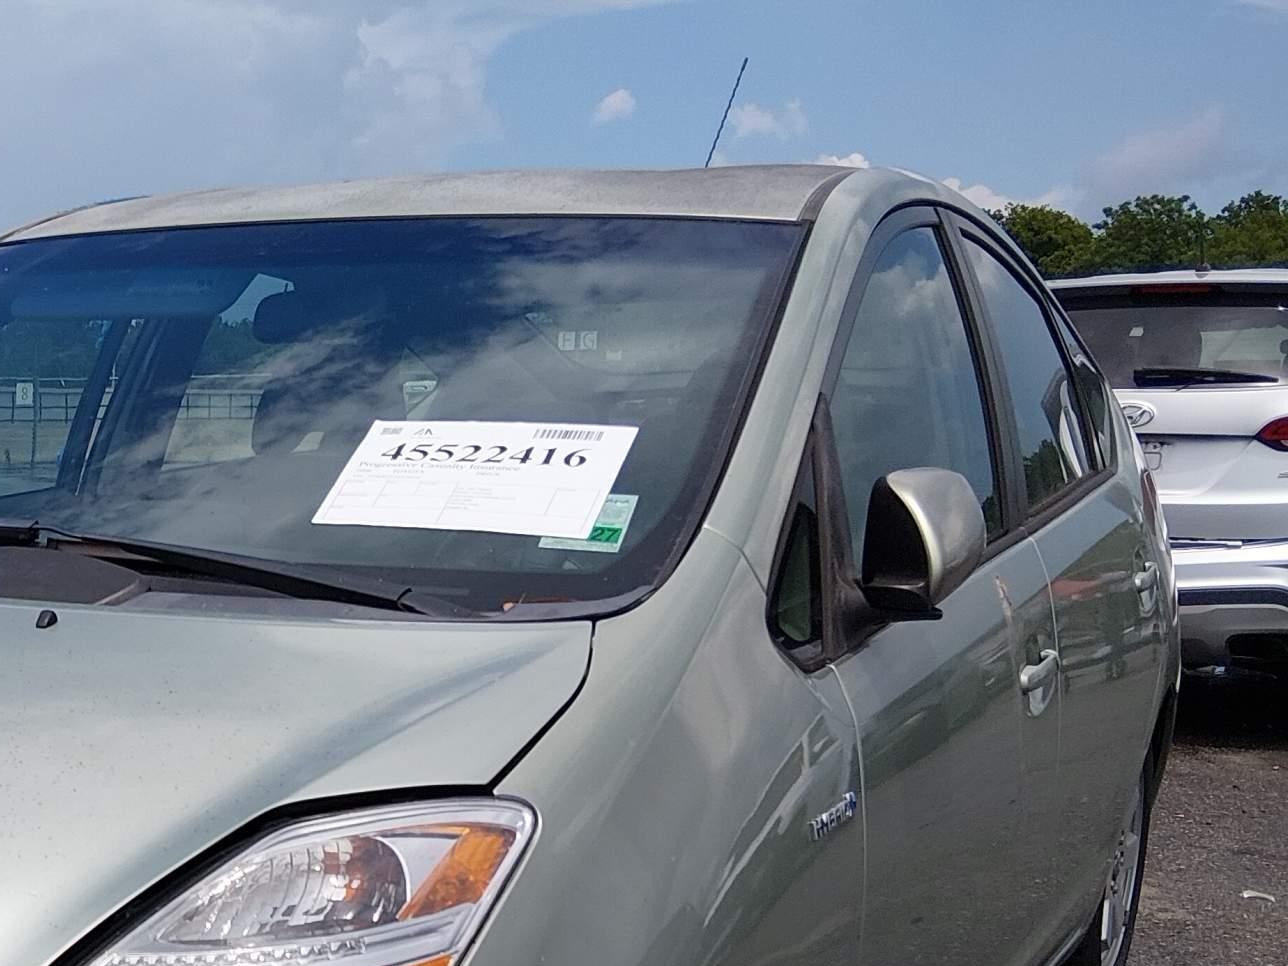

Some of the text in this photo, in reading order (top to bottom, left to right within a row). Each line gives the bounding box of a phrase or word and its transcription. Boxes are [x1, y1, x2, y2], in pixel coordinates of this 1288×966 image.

[21, 386, 29, 401] 8
[381, 443, 592, 467] 45522416
[591, 527, 619, 542] 27
